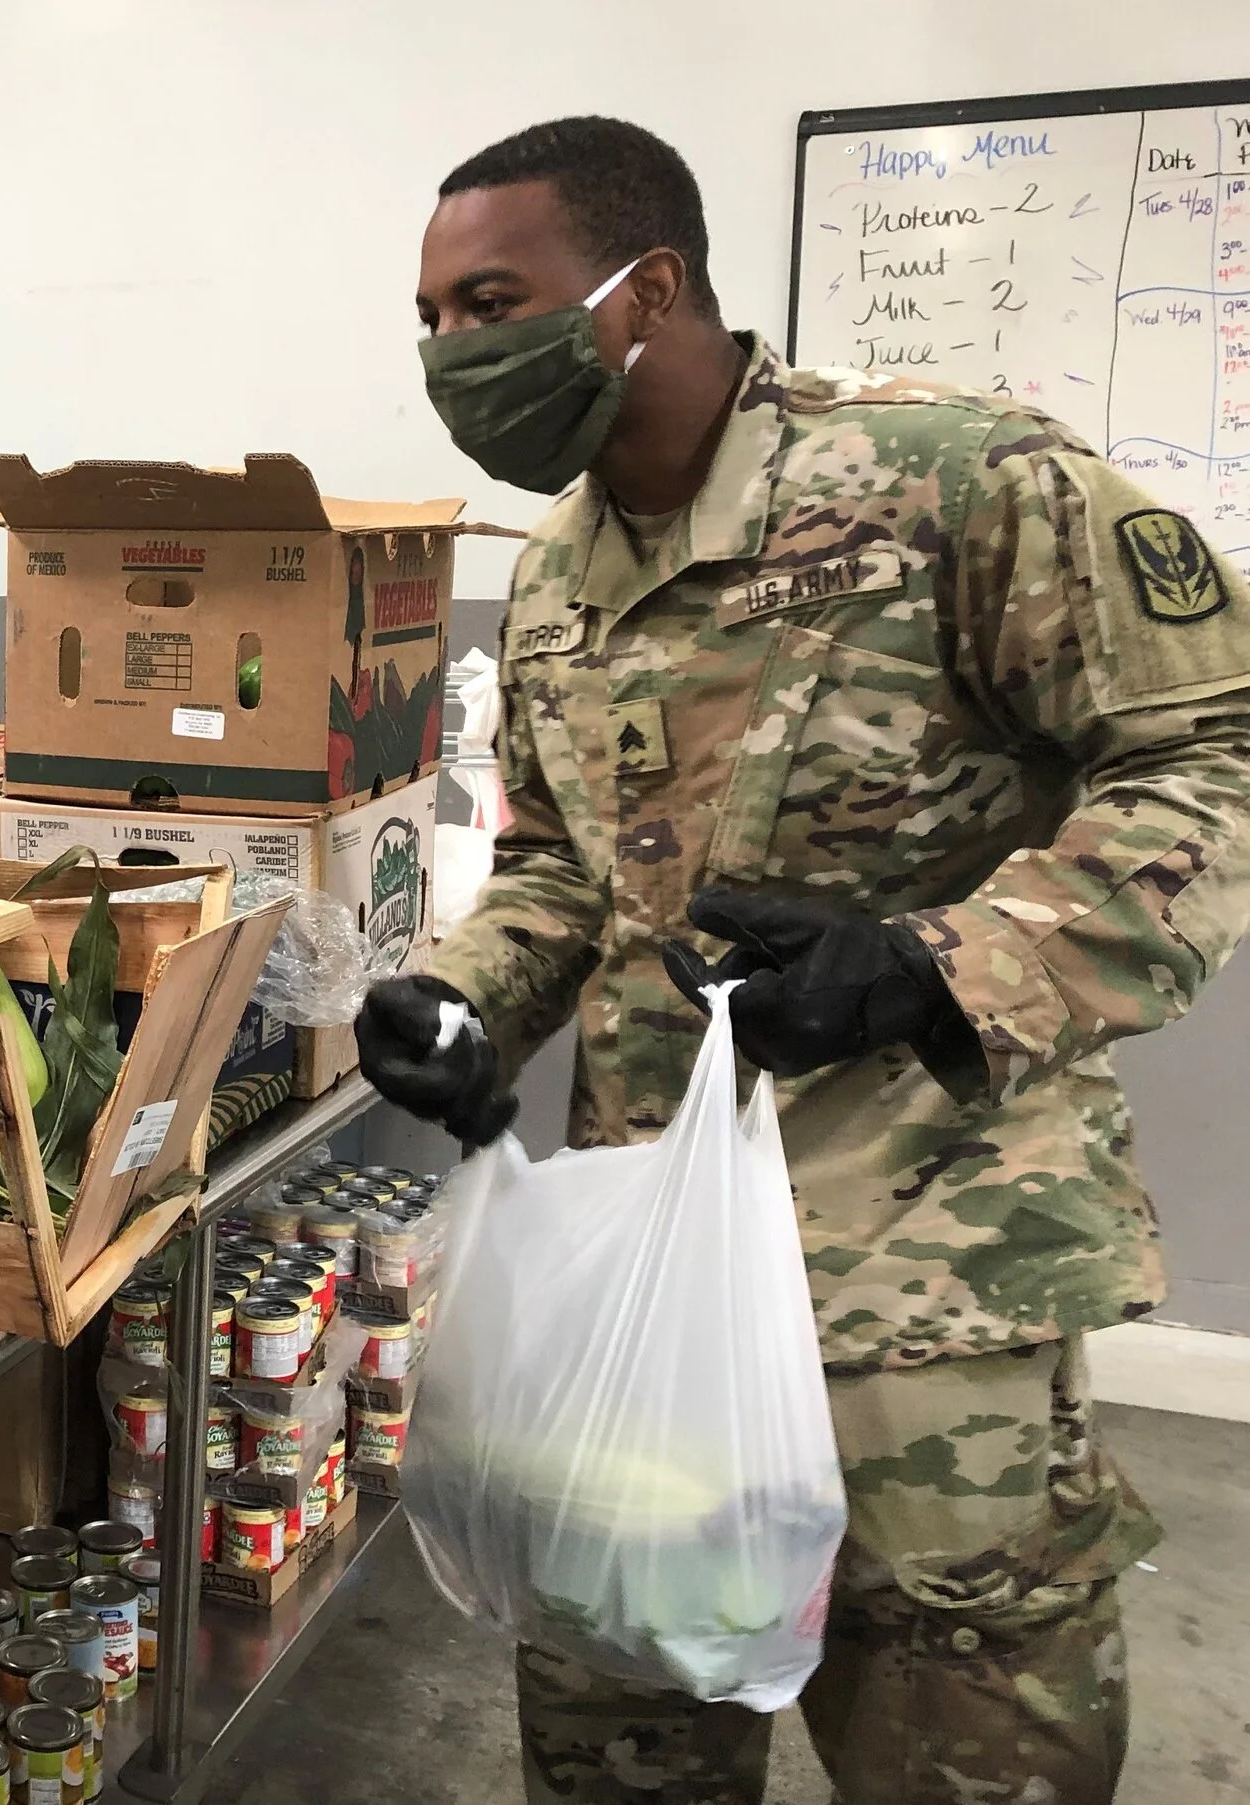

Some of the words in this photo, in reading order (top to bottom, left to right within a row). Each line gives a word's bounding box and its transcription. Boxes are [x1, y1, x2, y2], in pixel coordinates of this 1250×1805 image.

[858, 140, 946, 179] Happy
[962, 130, 1058, 168] Menu
[1148, 148, 1196, 172] Date
[1179, 188, 1213, 222] 4/28
[856, 203, 985, 238] Proteins
[853, 292, 930, 326] Milk
[991, 279, 1028, 311] 2
[855, 335, 938, 369] Juice
[29, 552, 65, 564] PRODUCE
[121, 547, 207, 566] VEGETABLES
[283, 546, 305, 566] 1/9
[26, 564, 38, 576] OF
[39, 564, 66, 576] MEXICO
[266, 568, 307, 582] BUSHEL
[789, 560, 860, 599] ARMY
[374, 578, 438, 628] VEGETABLES
[126, 632, 149, 641] BELL
[150, 632, 191, 642] PEPPERS
[127, 644, 165, 653] EX-LARGE
[127, 655, 153, 664] LARGE
[127, 667, 158, 675] MEDIUM
[127, 678, 152, 687] SMALL
[17, 819, 37, 828] BELL
[39, 821, 69, 830] PEPPER
[28, 829, 43, 838] XXL
[124, 827, 142, 840] 1/9
[145, 829, 195, 843] BUSHEL
[29, 839, 38, 848] XL
[247, 845, 287, 855] POBLANO
[256, 856, 287, 866] CARIBE
[123, 1326, 167, 1338] BOYARDE
